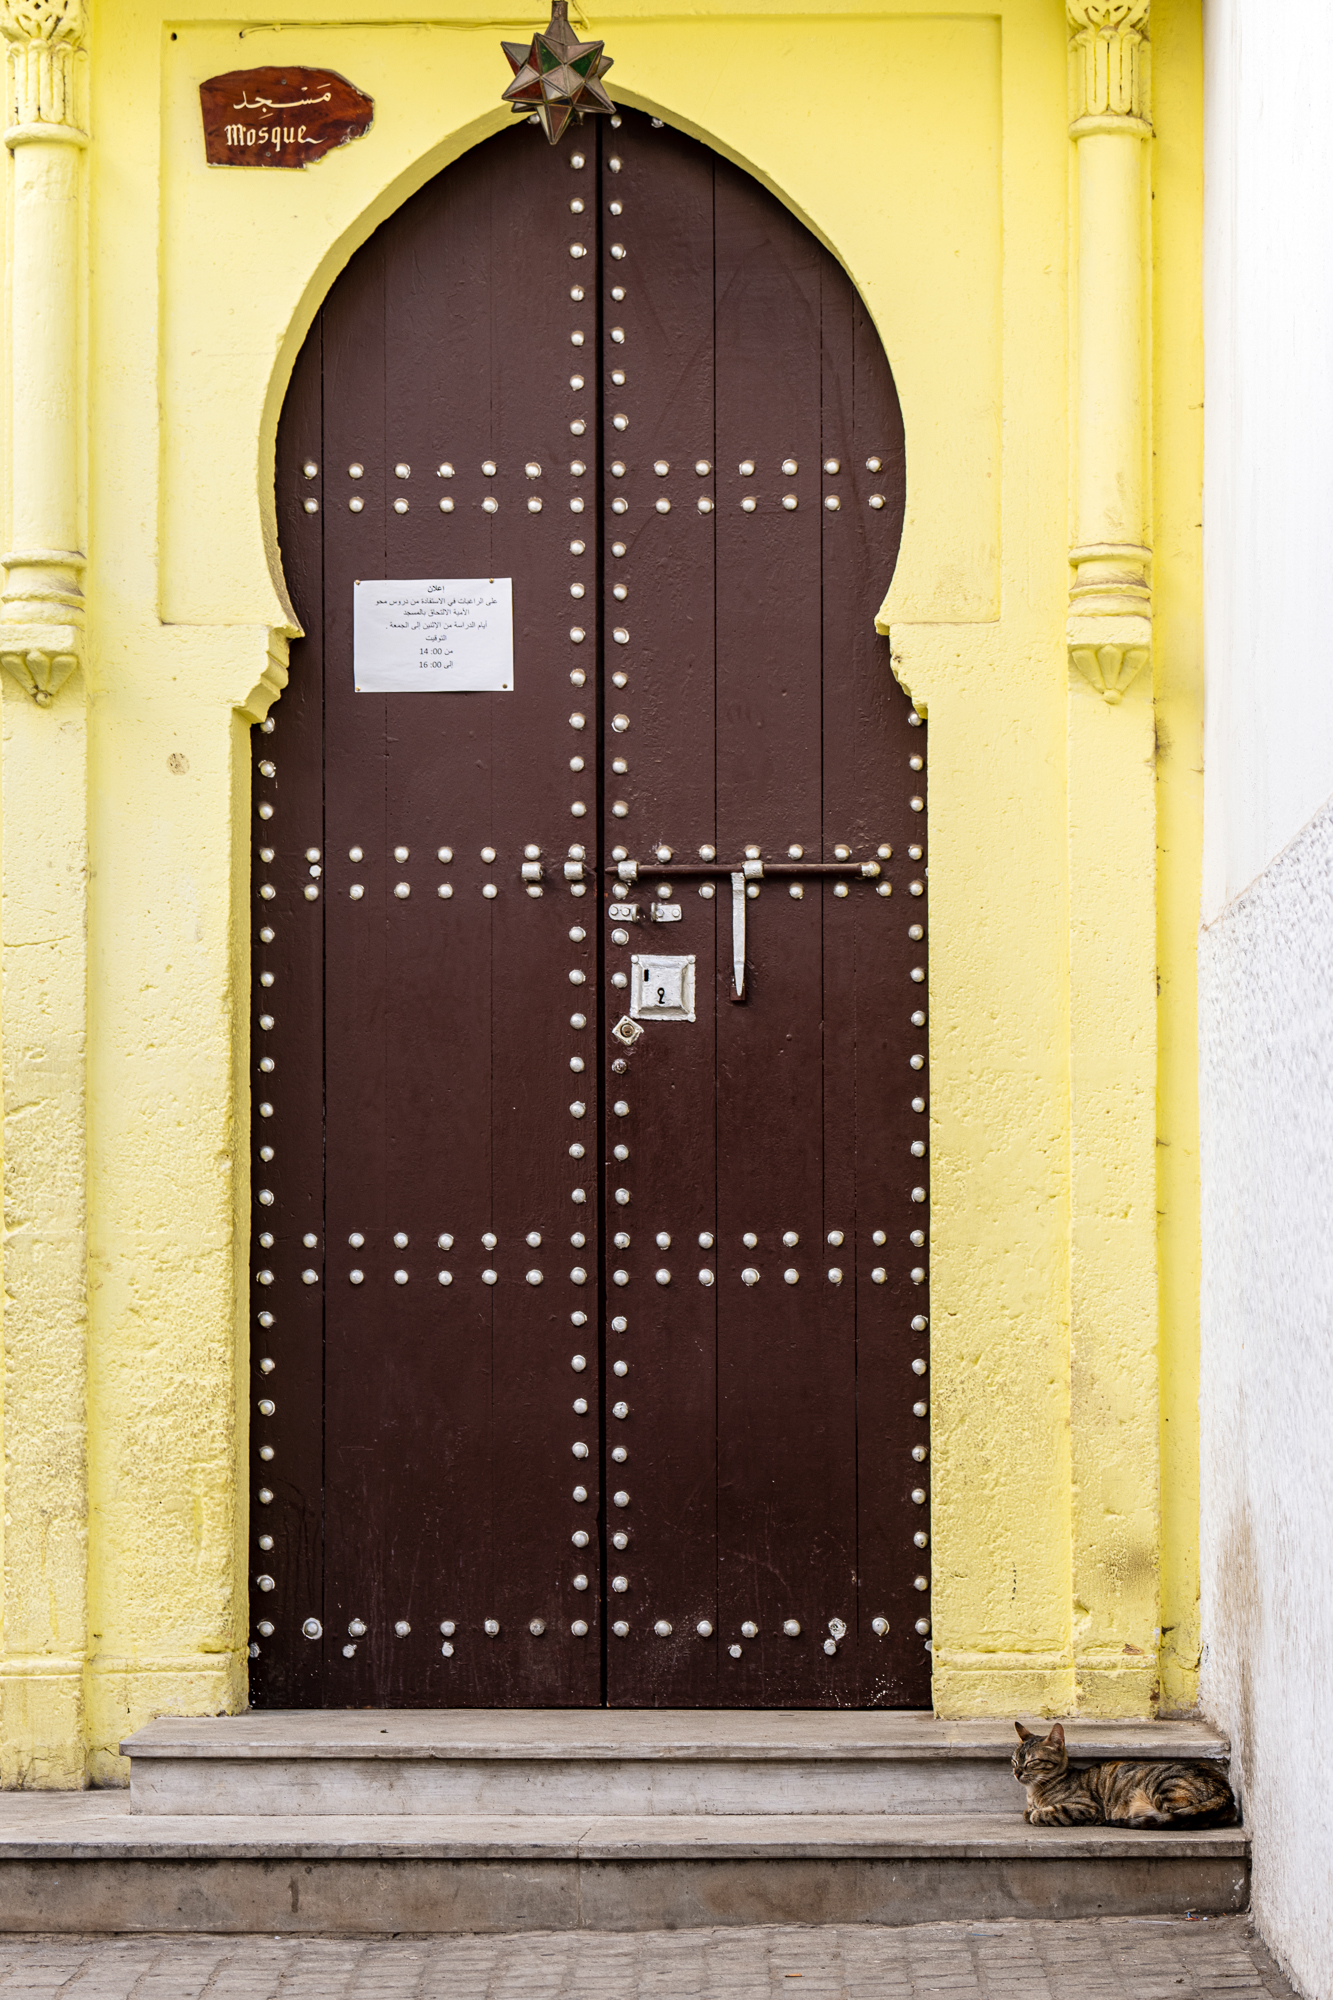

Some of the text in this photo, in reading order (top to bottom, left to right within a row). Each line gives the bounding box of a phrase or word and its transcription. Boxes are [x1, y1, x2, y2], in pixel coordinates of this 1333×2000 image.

[224, 123, 328, 152] Mosque
[427, 585, 445, 593] إعلان
[454, 621, 475, 629] الدراسة
[477, 620, 487, 629] أيام
